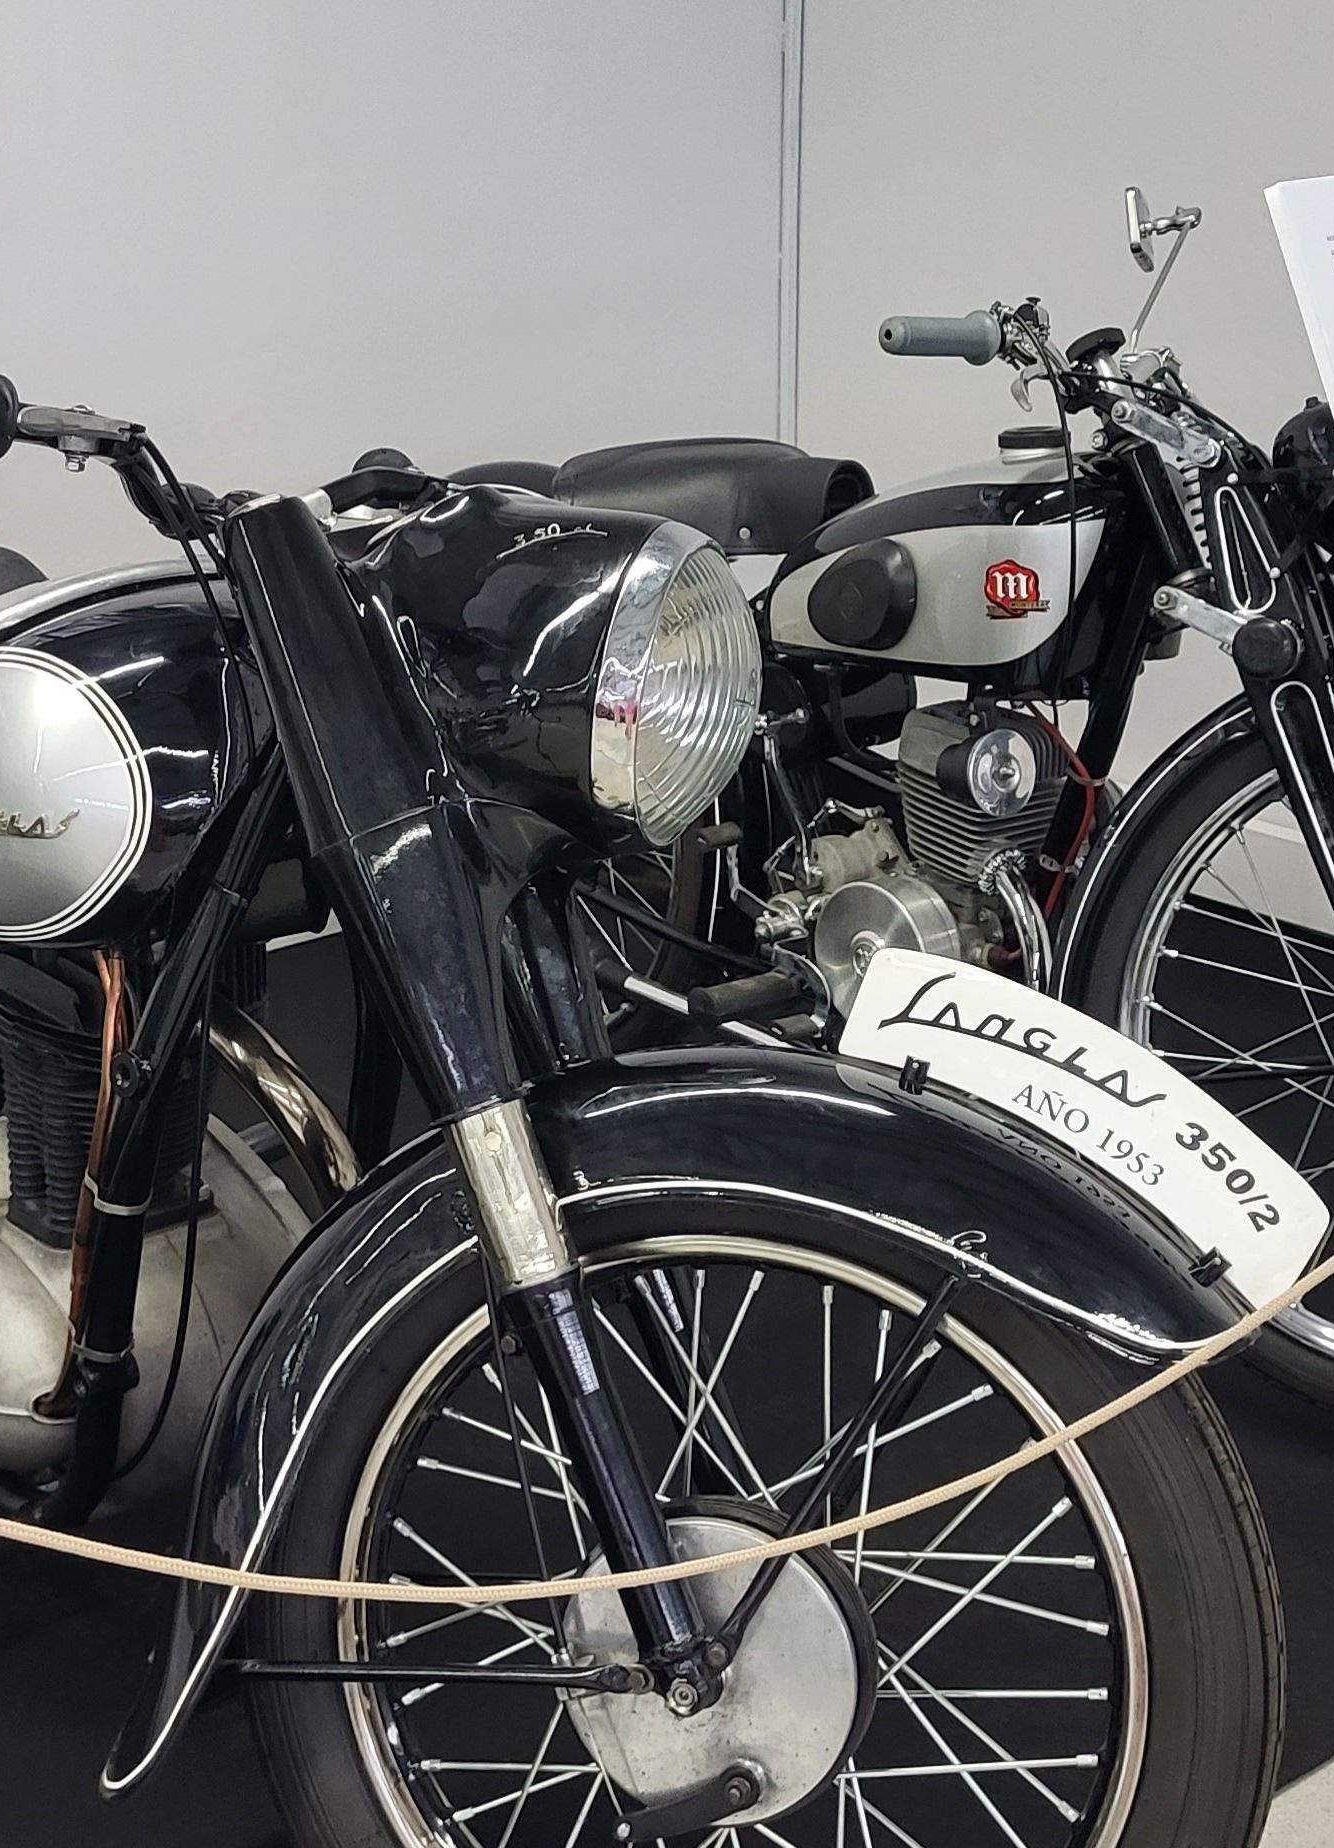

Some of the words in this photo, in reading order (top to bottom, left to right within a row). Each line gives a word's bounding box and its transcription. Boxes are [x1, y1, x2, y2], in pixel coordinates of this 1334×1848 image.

[1012, 1083, 1091, 1134] AÑO
[1096, 1128, 1166, 1186] 1953
[1176, 1122, 1281, 1233] 350/2
